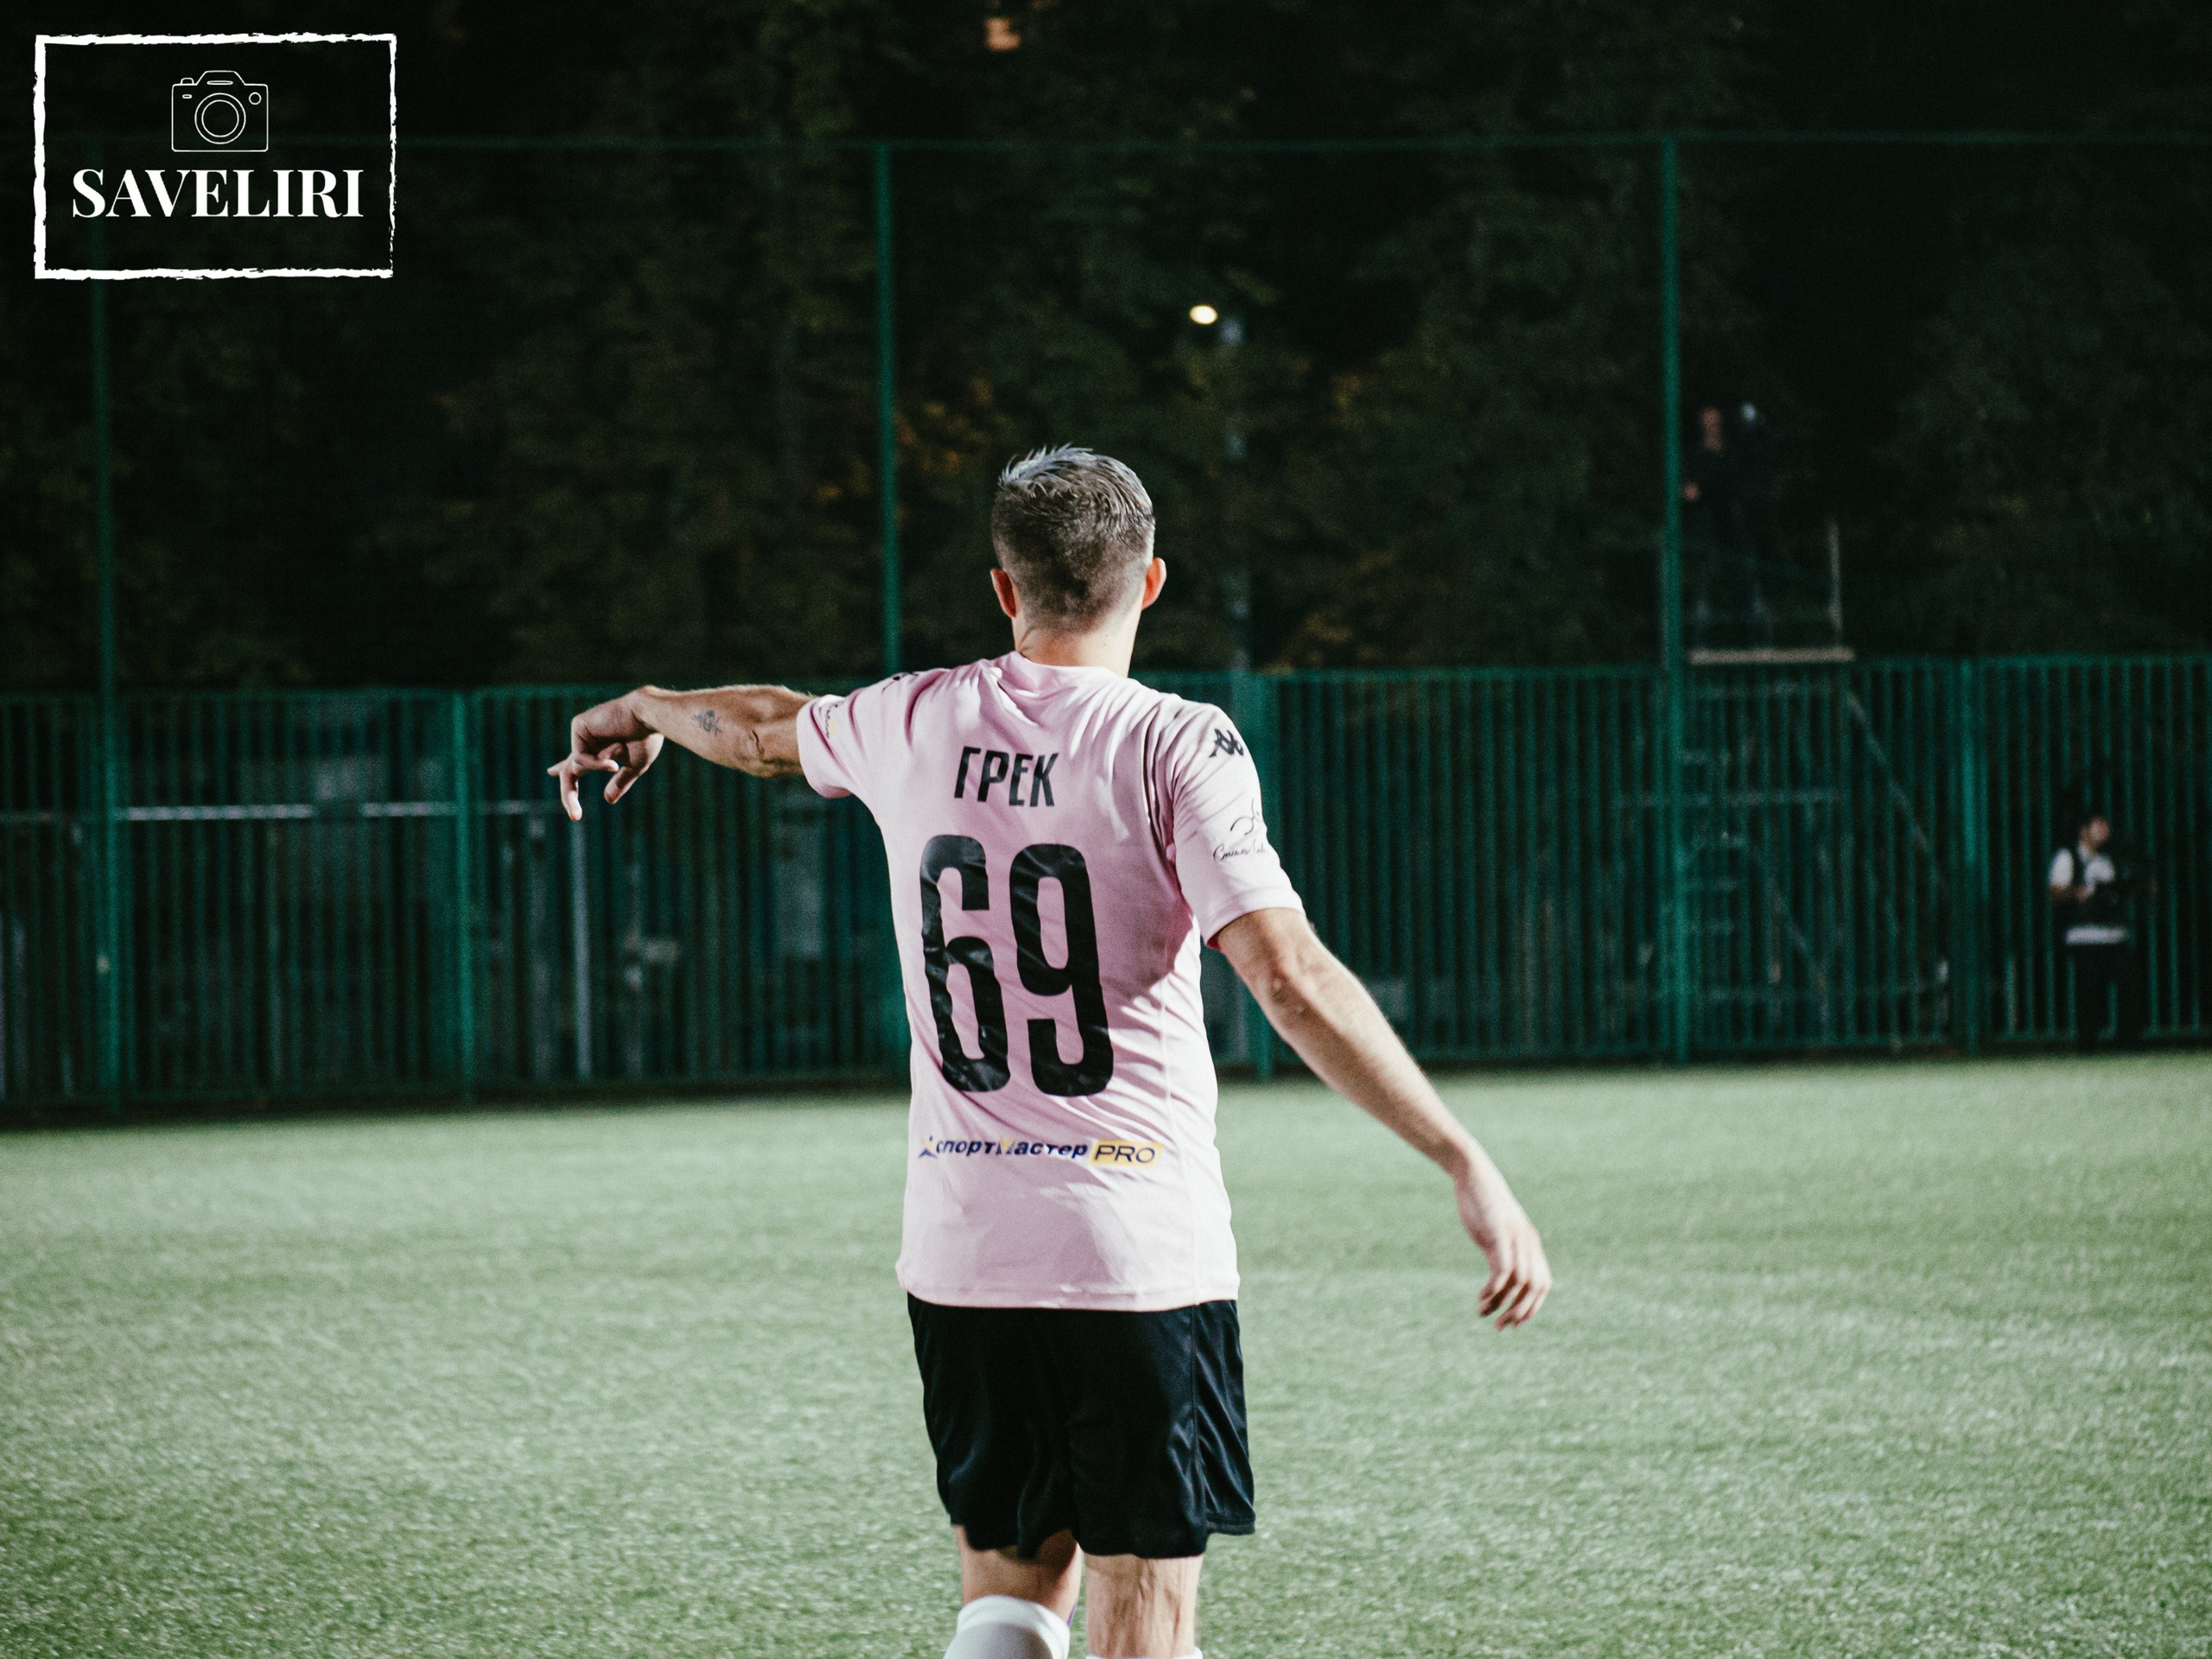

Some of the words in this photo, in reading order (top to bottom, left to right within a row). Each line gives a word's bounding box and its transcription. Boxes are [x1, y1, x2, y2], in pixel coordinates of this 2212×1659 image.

[953, 746, 1059, 808] ГРЕК
[919, 834, 1115, 1097] 69
[1094, 1144, 1156, 1164] PRO
